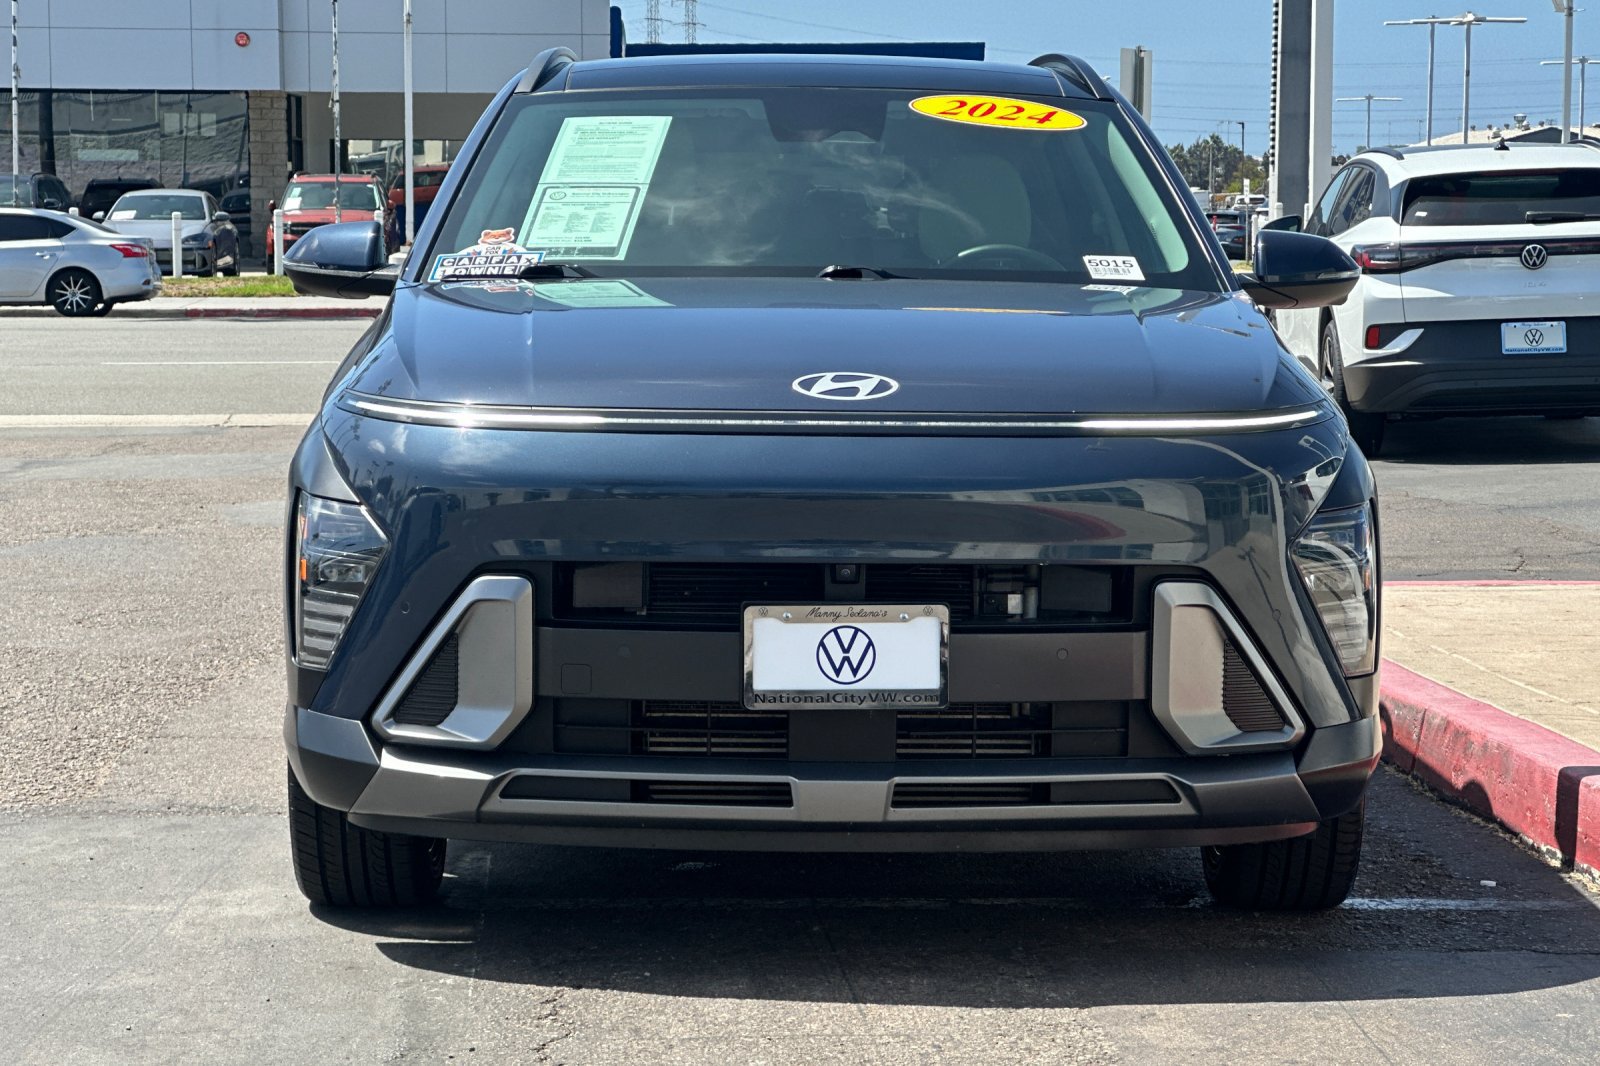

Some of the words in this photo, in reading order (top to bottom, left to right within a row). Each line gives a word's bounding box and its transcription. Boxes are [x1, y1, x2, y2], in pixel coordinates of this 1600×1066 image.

[937, 100, 1058, 124] 2024
[443, 255, 535, 266] CARFAX
[1088, 259, 1134, 268] 5015
[455, 266, 525, 275] OWNE
[805, 606, 842, 622] Manny
[754, 692, 940, 705] NationalCityVW.com
